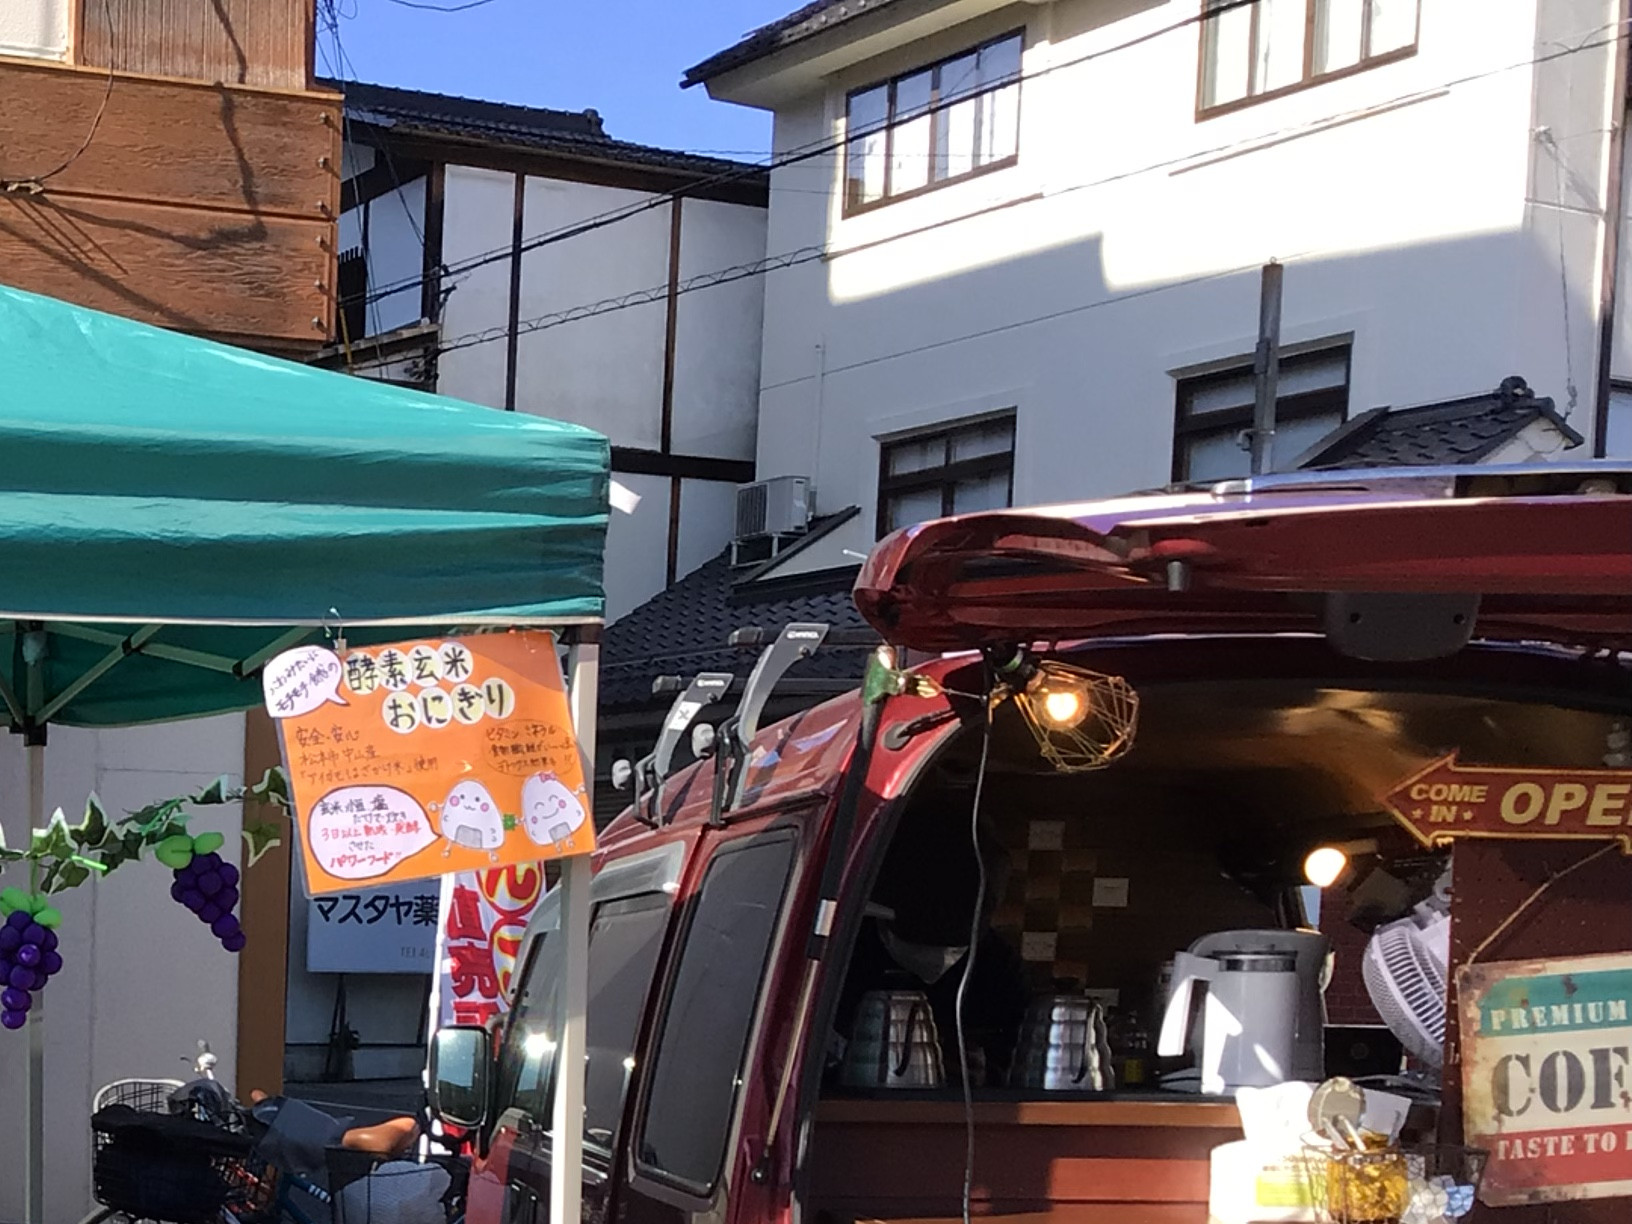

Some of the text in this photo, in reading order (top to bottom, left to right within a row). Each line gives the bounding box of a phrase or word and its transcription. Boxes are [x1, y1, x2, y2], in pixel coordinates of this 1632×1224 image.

[347, 647, 469, 691] 酵素玄米
[388, 683, 506, 728] おにぎり
[1409, 784, 1488, 803] COME
[1500, 782, 1632, 826] OPE
[1429, 805, 1457, 823] IN
[1490, 1000, 1627, 1031] PREMIUM
[1498, 1134, 1576, 1161] TASTE
[1584, 1131, 1617, 1155] TO
